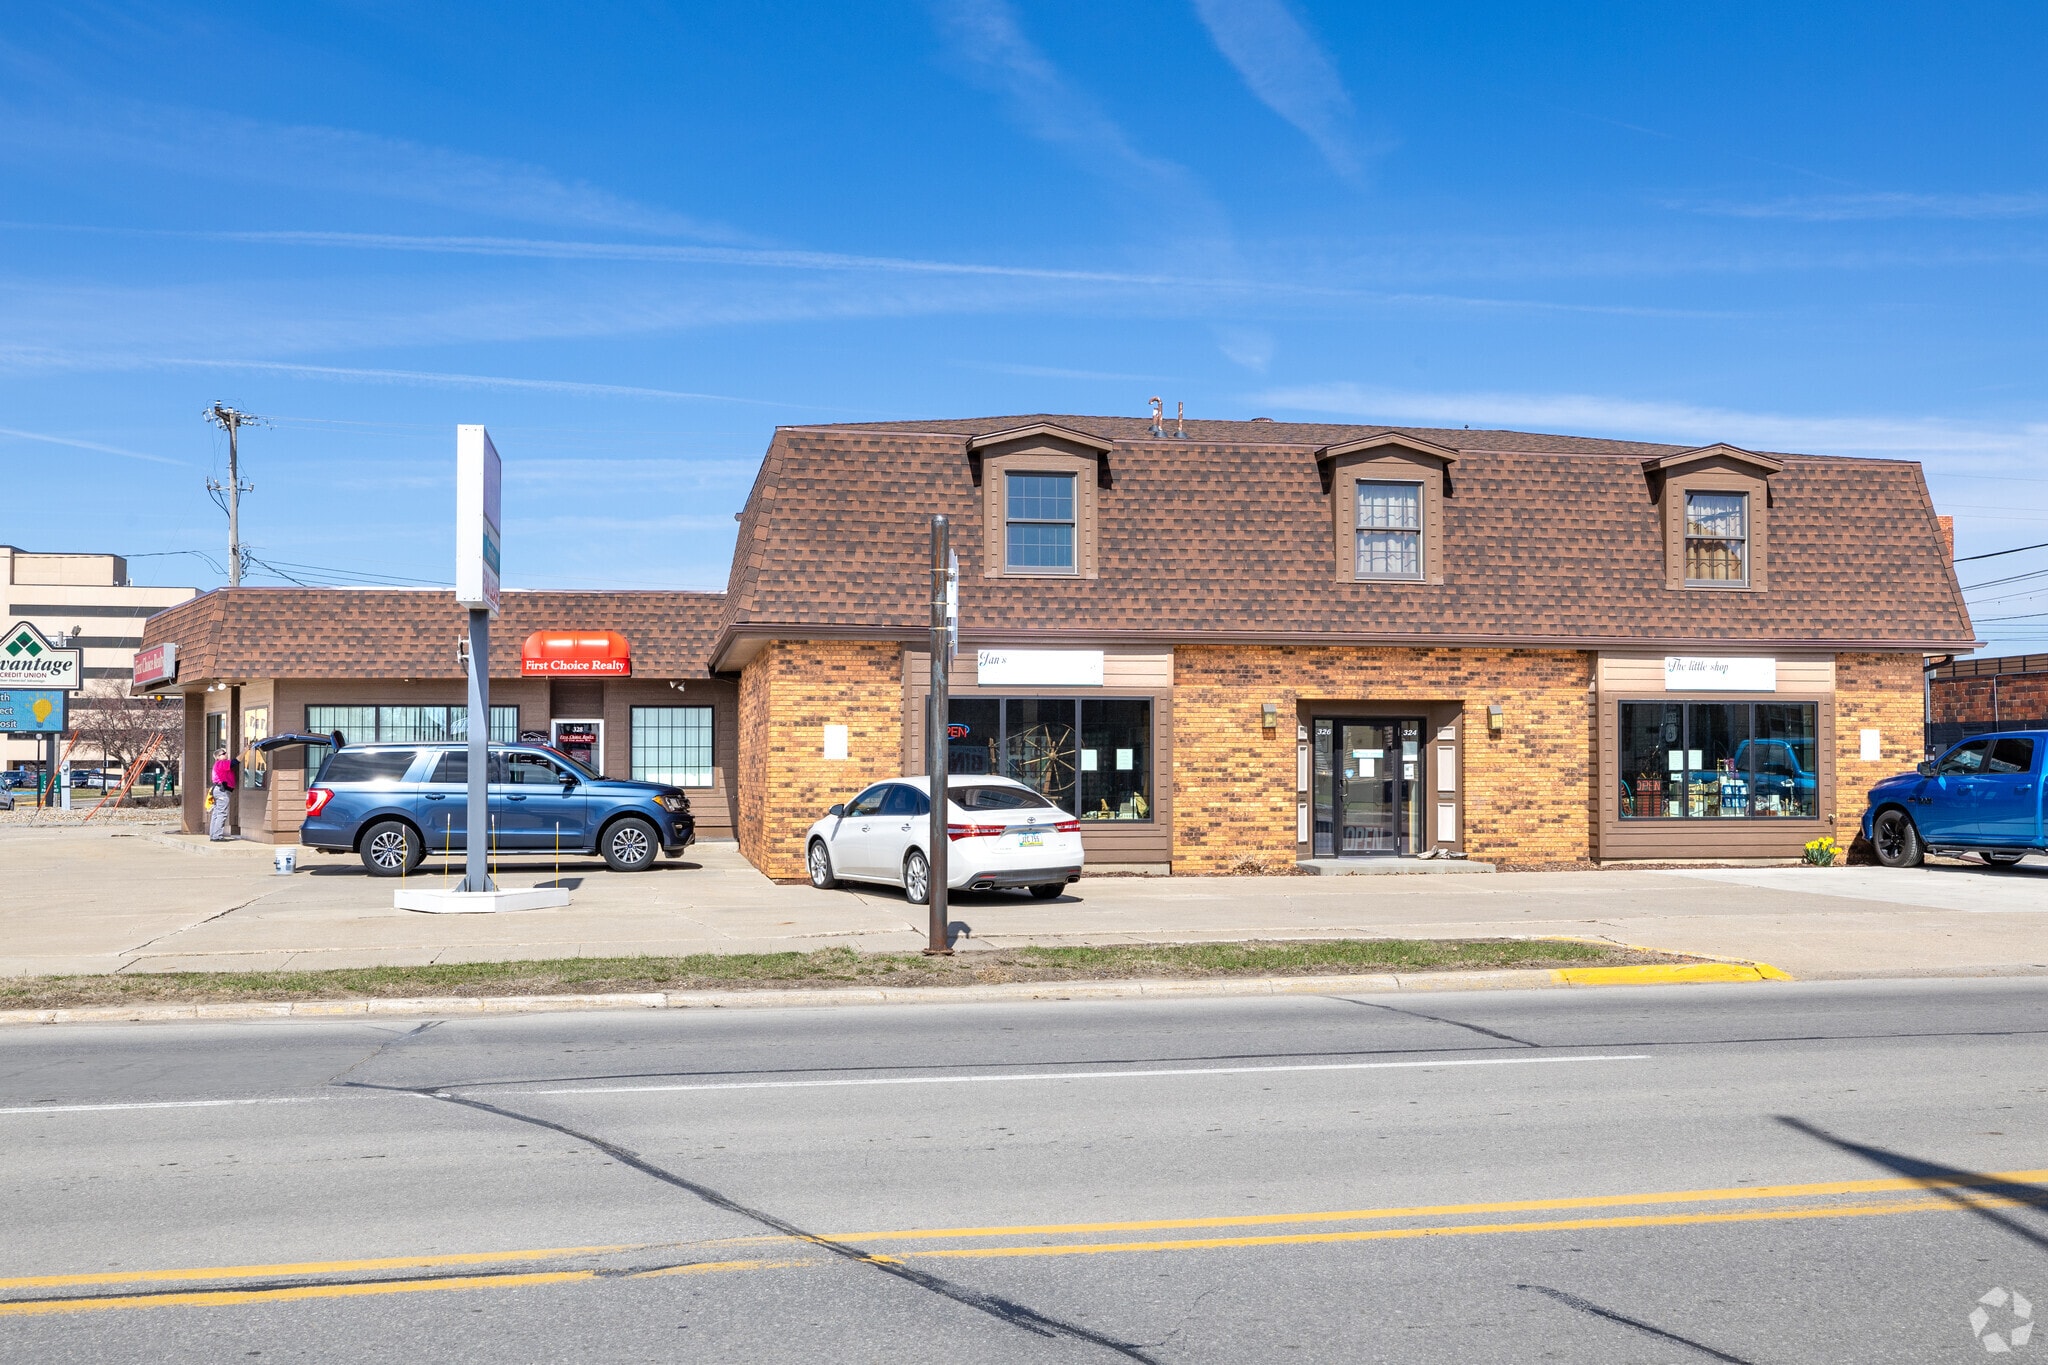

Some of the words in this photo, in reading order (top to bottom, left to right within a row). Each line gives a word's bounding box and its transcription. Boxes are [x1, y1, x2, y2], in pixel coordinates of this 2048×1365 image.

[0, 658, 73, 676] vantage
[526, 660, 548, 671] First
[551, 660, 589, 671] Choice
[592, 660, 625, 673] Realty
[1668, 658, 1686, 672] The
[1688, 660, 1707, 671] little
[1710, 661, 1729, 675] shop
[0, 692, 10, 702] th
[0, 707, 13, 715] ect
[0, 720, 17, 729] osit
[948, 727, 967, 738] PEN
[1637, 780, 1661, 791] OPEN
[1346, 827, 1384, 850] OPEN
